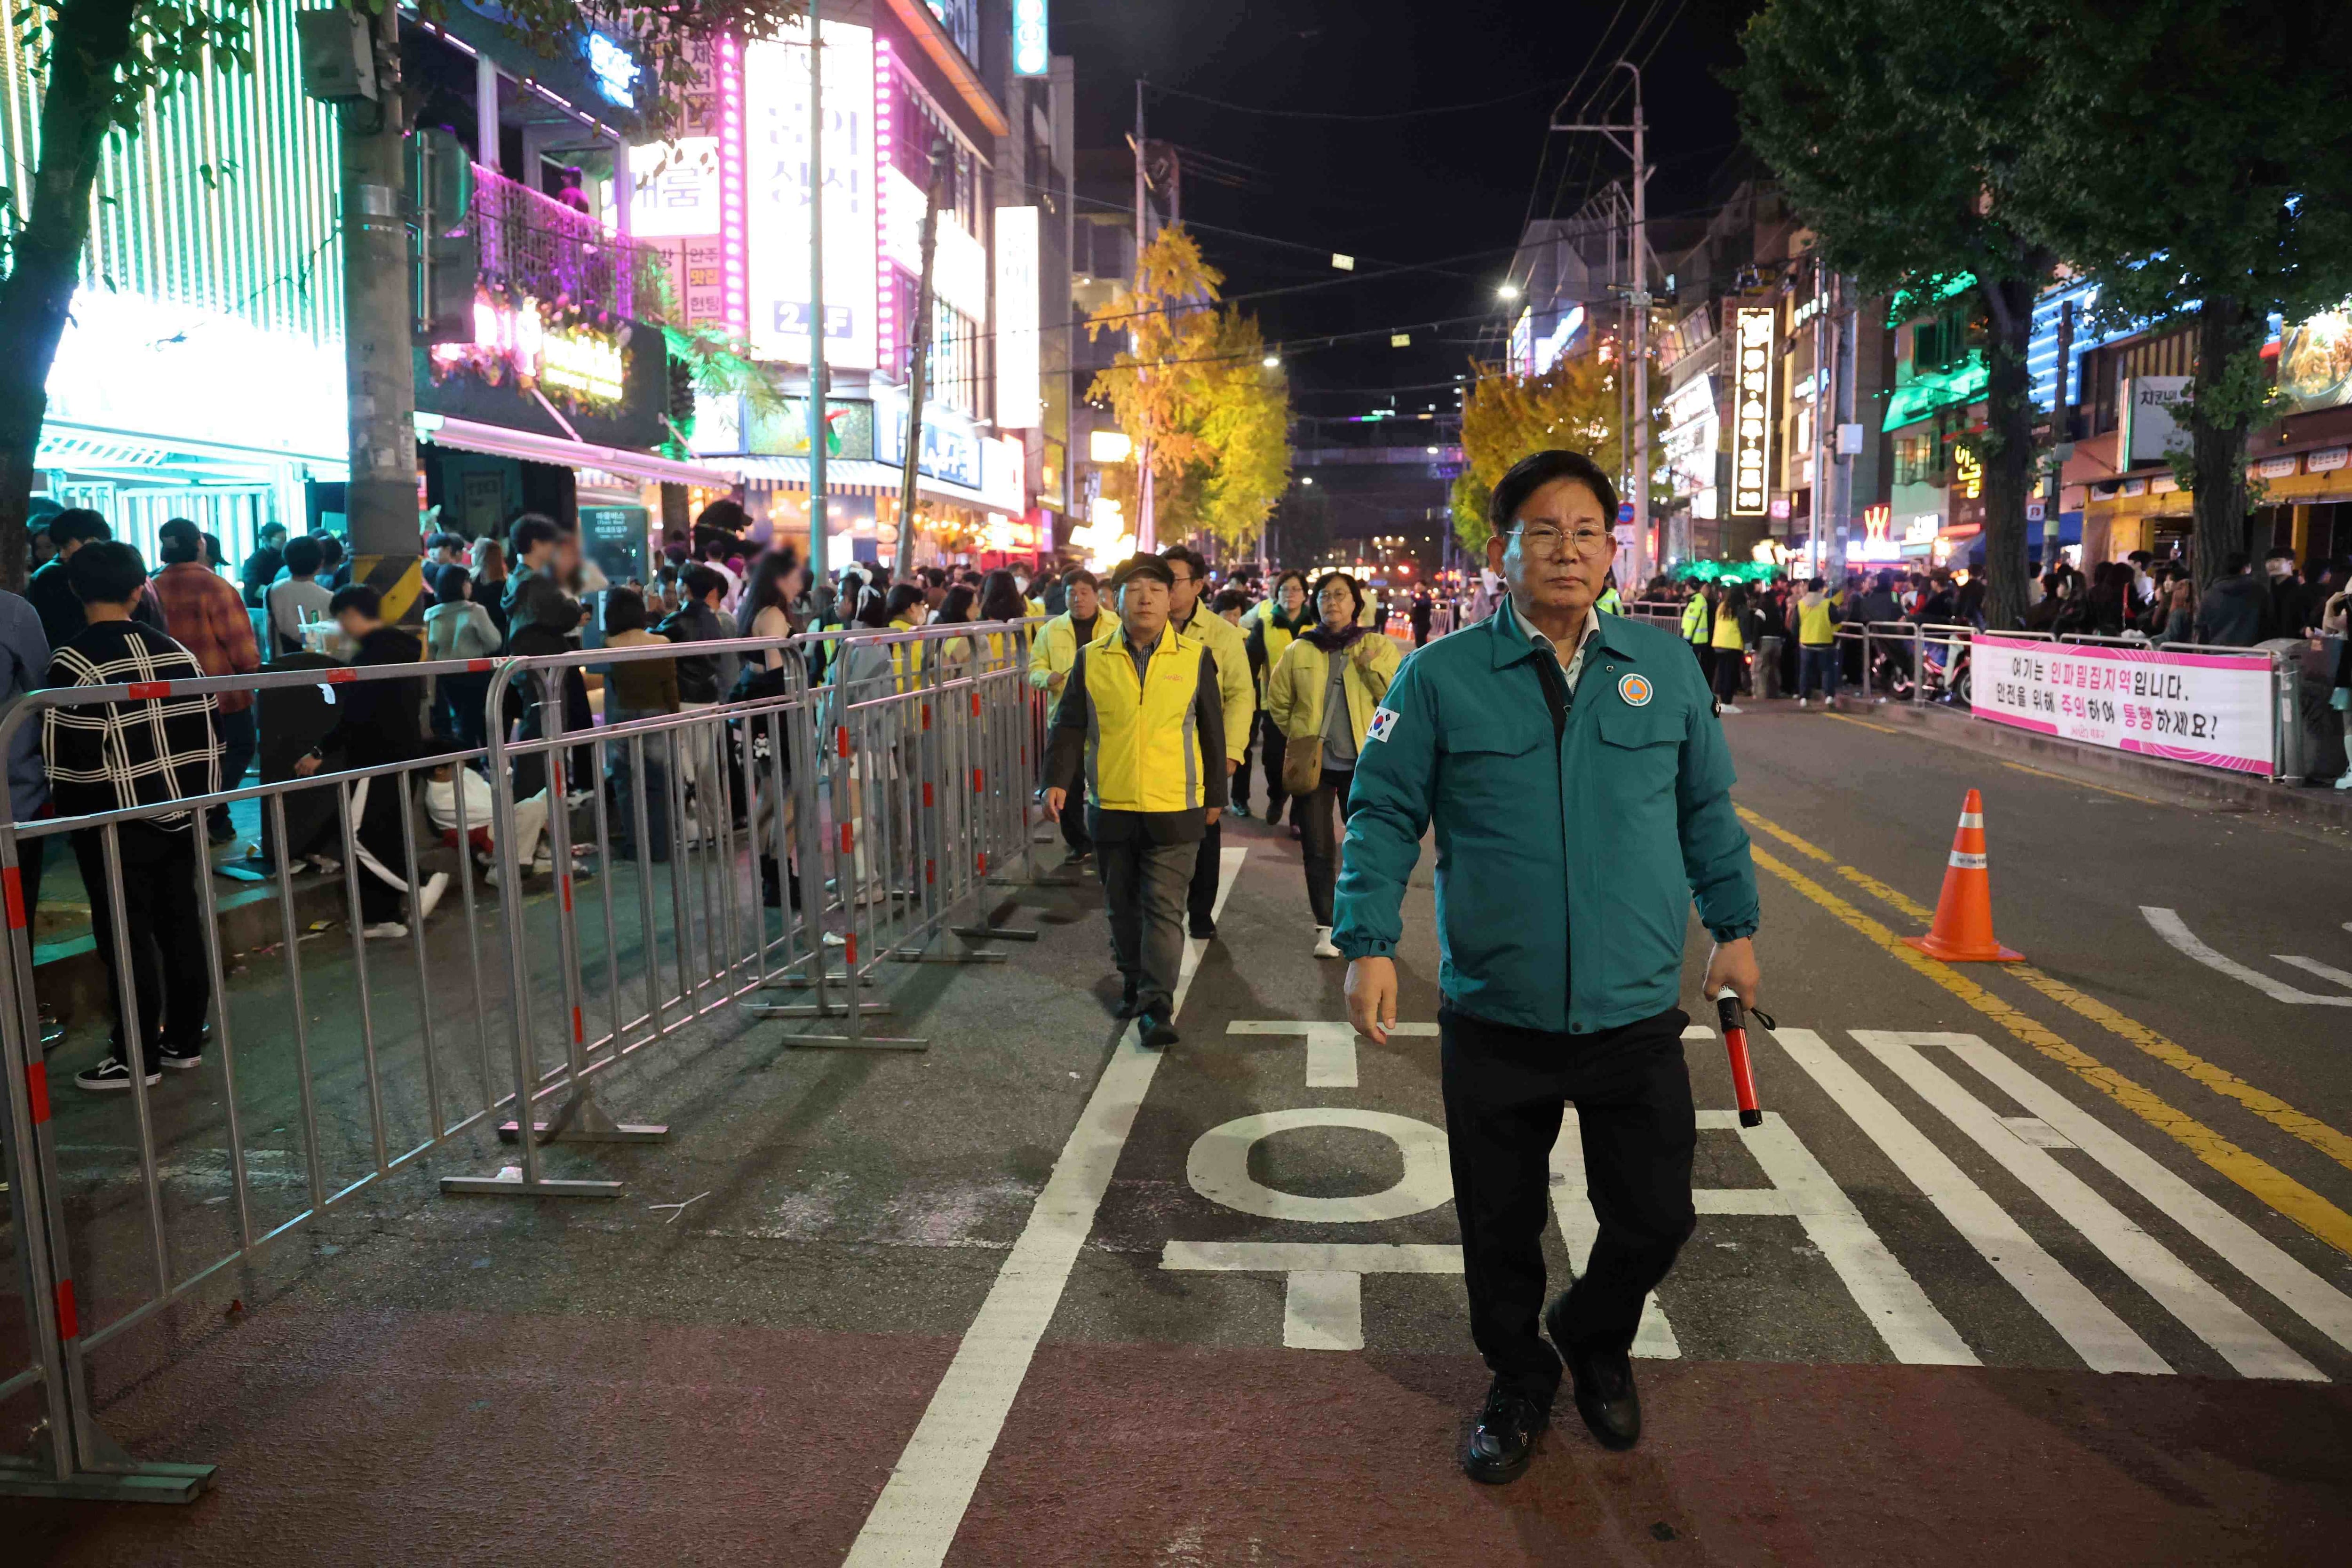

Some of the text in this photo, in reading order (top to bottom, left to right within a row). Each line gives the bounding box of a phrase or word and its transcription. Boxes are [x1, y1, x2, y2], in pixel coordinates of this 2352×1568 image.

[2013, 657, 2189, 701] 여기는 인파밀집지역입니다.
[1997, 682, 2026, 707] 안전을
[2033, 689, 2055, 713] 위해
[2061, 694, 2114, 724] 주의하여
